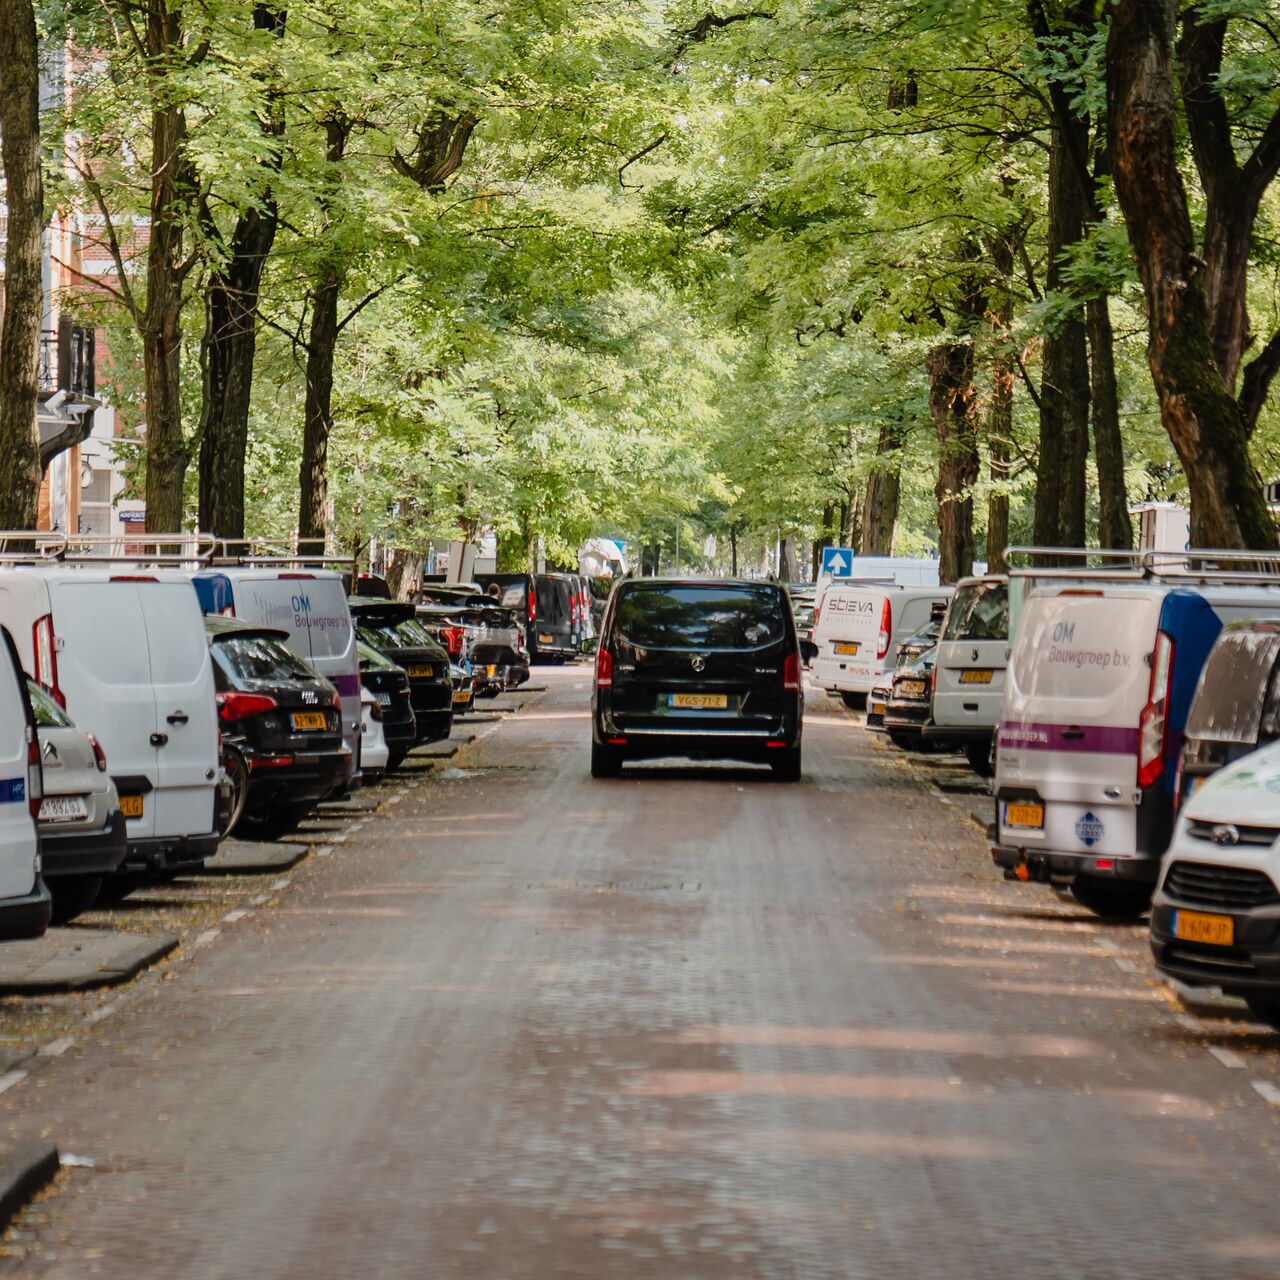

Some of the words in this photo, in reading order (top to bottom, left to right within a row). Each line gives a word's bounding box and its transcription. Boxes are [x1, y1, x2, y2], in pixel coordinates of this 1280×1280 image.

[291, 595, 311, 613] OM
[1052, 622, 1076, 643] OM
[1048, 646, 1111, 669] Bouwgroep
